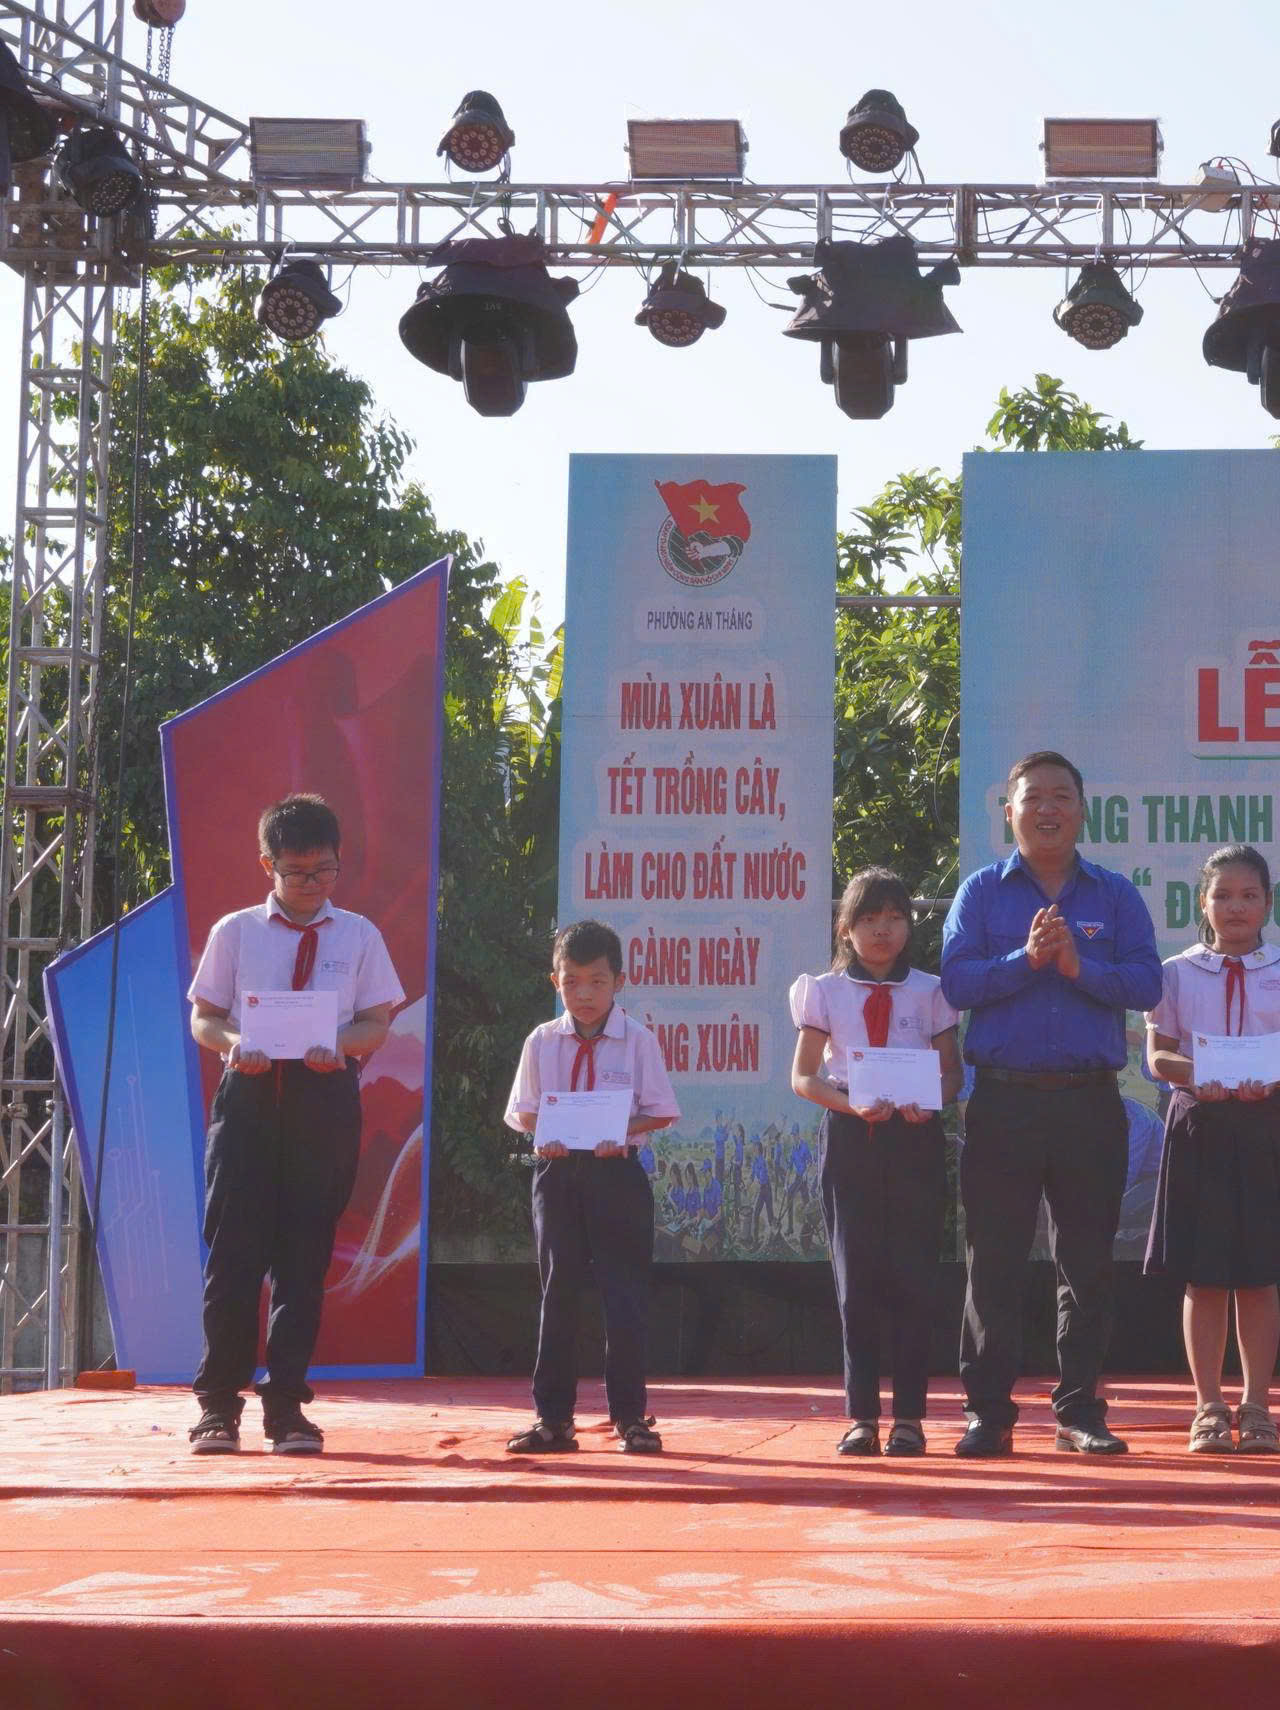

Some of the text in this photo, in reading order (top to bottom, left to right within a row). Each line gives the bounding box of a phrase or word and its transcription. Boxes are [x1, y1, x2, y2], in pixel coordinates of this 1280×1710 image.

[647, 606, 695, 630] PHƯỜNG
[697, 611, 713, 630] AN
[620, 672, 776, 731] MÙA XUÂN LÀ
[607, 751, 786, 821] TẾT TRỒNG CÂY,
[1143, 794, 1277, 843] THANH
[584, 835, 806, 900] LÀM CHO ĐẤT NƯỚC
[628, 927, 760, 986] CÀNG NGÀY
[696, 1013, 760, 1073] XUÂN
